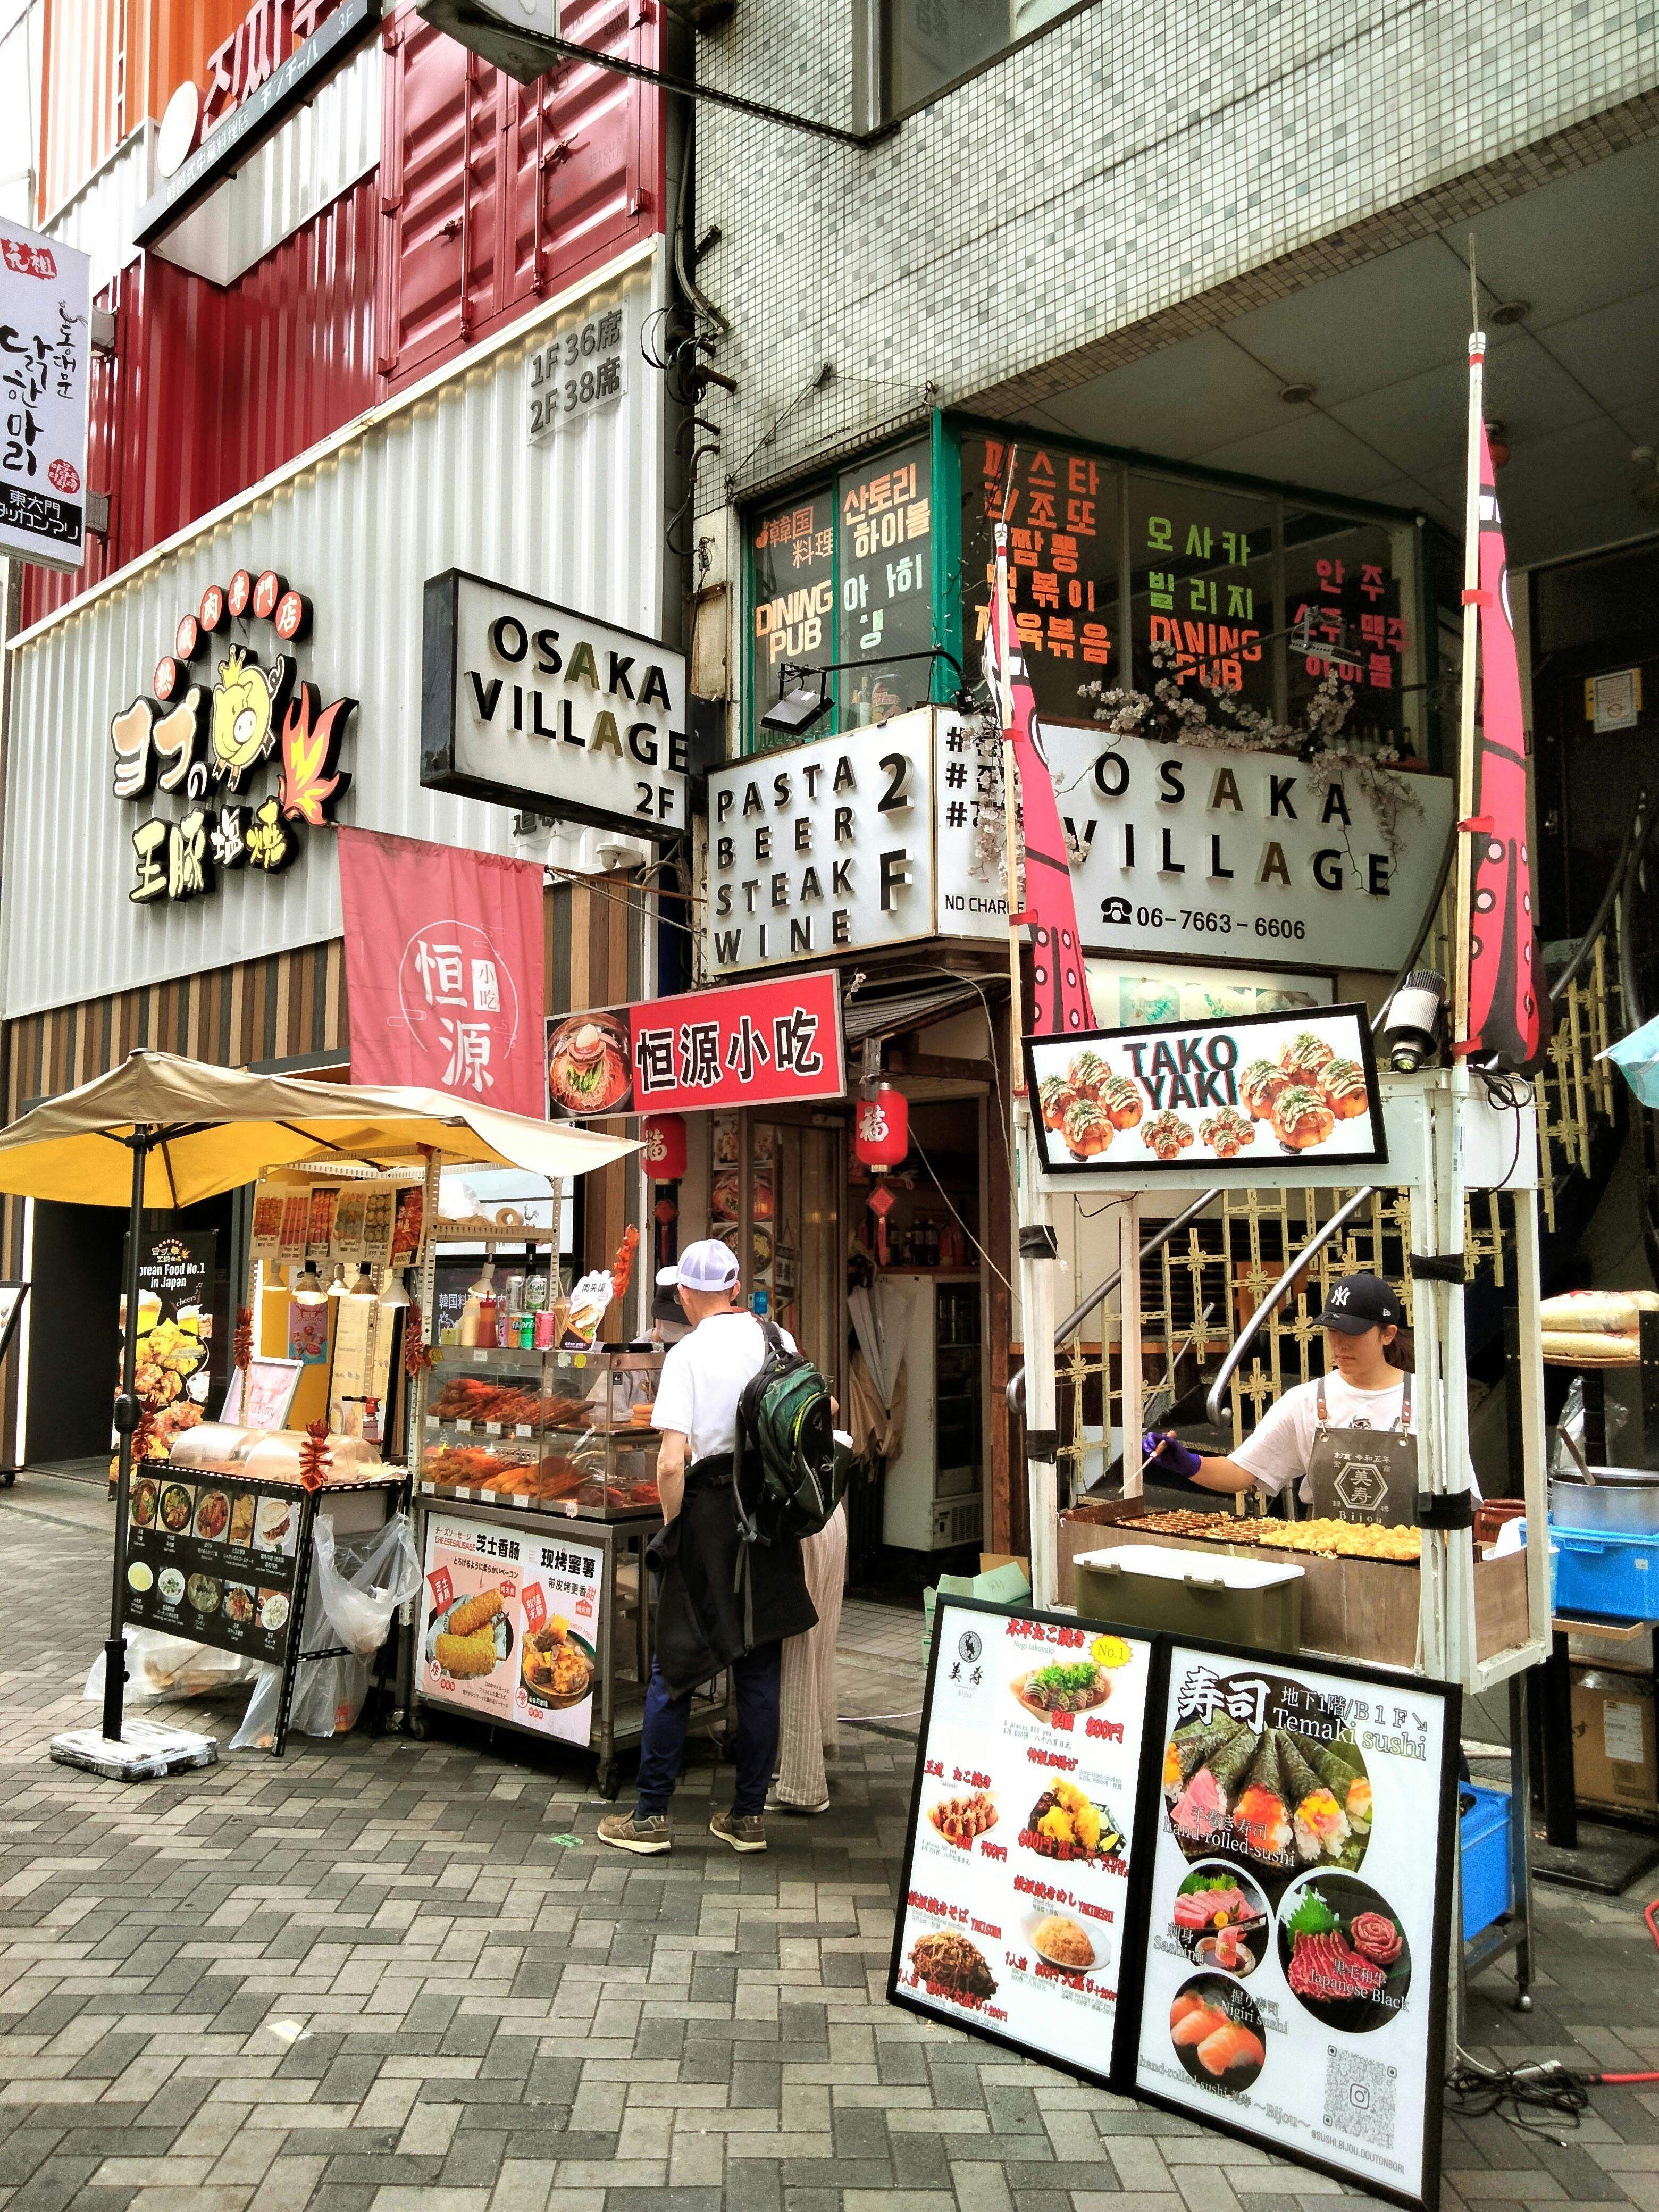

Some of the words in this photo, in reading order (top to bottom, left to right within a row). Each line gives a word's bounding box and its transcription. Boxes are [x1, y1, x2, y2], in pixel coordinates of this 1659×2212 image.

[338, 3, 354, 35] 3F
[6, 242, 55, 277] 元祖
[531, 342, 559, 388] 1F
[565, 308, 622, 368] 36席
[530, 389, 557, 433] 2F
[564, 356, 622, 413] 38席
[10, 489, 60, 519] 東大門
[843, 462, 917, 526] 산토리
[769, 506, 814, 548] 韓国
[793, 527, 833, 569] 料理
[854, 498, 931, 558] 하이볼
[1147, 516, 1251, 567] 오사카
[1010, 527, 1079, 574] 짬뽕
[1149, 571, 1253, 621] 빌리지
[1316, 559, 1385, 602] 안주
[755, 579, 833, 638] DINING
[155, 573, 301, 696] 熟成肉専門店
[769, 616, 822, 664] PUB
[1150, 615, 1262, 662] DINING
[490, 615, 672, 713] OSAKA
[1176, 653, 1243, 691] PUB
[465, 671, 690, 775] VILLAGE
[634, 781, 675, 820] 2F
[717, 755, 858, 823] PASTA
[877, 752, 915, 815] 2
[1091, 751, 1352, 826] OSAKA
[717, 806, 856, 870] BEER
[1062, 816, 1391, 896] VILLAGE
[716, 858, 856, 917] STEAK
[879, 848, 914, 913] F
[945, 894, 965, 911] NO
[714, 909, 852, 964] WINE
[477, 963, 498, 1011] 小吃
[415, 939, 495, 1093] 恒源
[635, 1005, 823, 1096] 恒源小吃
[1122, 1034, 1239, 1078] TAKO
[1139, 1069, 1240, 1111] YAKI
[859, 1104, 889, 1143] 福
[642, 1128, 668, 1162] 福
[150, 1276, 159, 1288] in
[160, 1277, 187, 1291] Japan
[164, 1262, 185, 1275] Food
[186, 1262, 206, 1275] No.1
[527, 1280, 547, 1292] Asahi
[175, 1294, 197, 1306] cheers
[1355, 1454, 1392, 1464] 令和五年
[1350, 1470, 1372, 1504] 美寿
[435, 1526, 472, 1541] チーズソーセージ
[1338, 1510, 1382, 1524] Bijou
[476, 1533, 520, 1561] 芝士香肠
[540, 1547, 596, 1578] 现烤蜜薯
[548, 1577, 597, 1603] 带皮烤更香甜
[1013, 1639, 1028, 1651] Negi
[1028, 1643, 1055, 1655] takoyaki
[1097, 1643, 1125, 1661] No.1
[1177, 1666, 1271, 1736] 寿司
[1085, 1716, 1124, 1744] 800円
[1273, 1707, 1356, 1745] Temaki
[1362, 1730, 1427, 1761] sushi
[1079, 1768, 1103, 1780] deep-fried
[1103, 1774, 1122, 1783] chicken
[1018, 1827, 1053, 1854] 600円
[1162, 1815, 1295, 1867] hand-rolled-sushi
[1191, 1805, 1268, 1841] 手巻き寿司
[981, 1840, 1008, 1863] 700円
[1044, 1900, 1054, 1909] rice
[1153, 1935, 1205, 1965] Sashimi
[1166, 1921, 1194, 1946] 刺身
[1308, 1968, 1369, 1999] Japanese
[1372, 1987, 1411, 2014] Black
[1333, 1959, 1387, 1989] 黒毛和牛
[1221, 2000, 1254, 2024] Nigiri
[1256, 2014, 1289, 2035] sushi
[1230, 1988, 1280, 2017] 握り寿司
